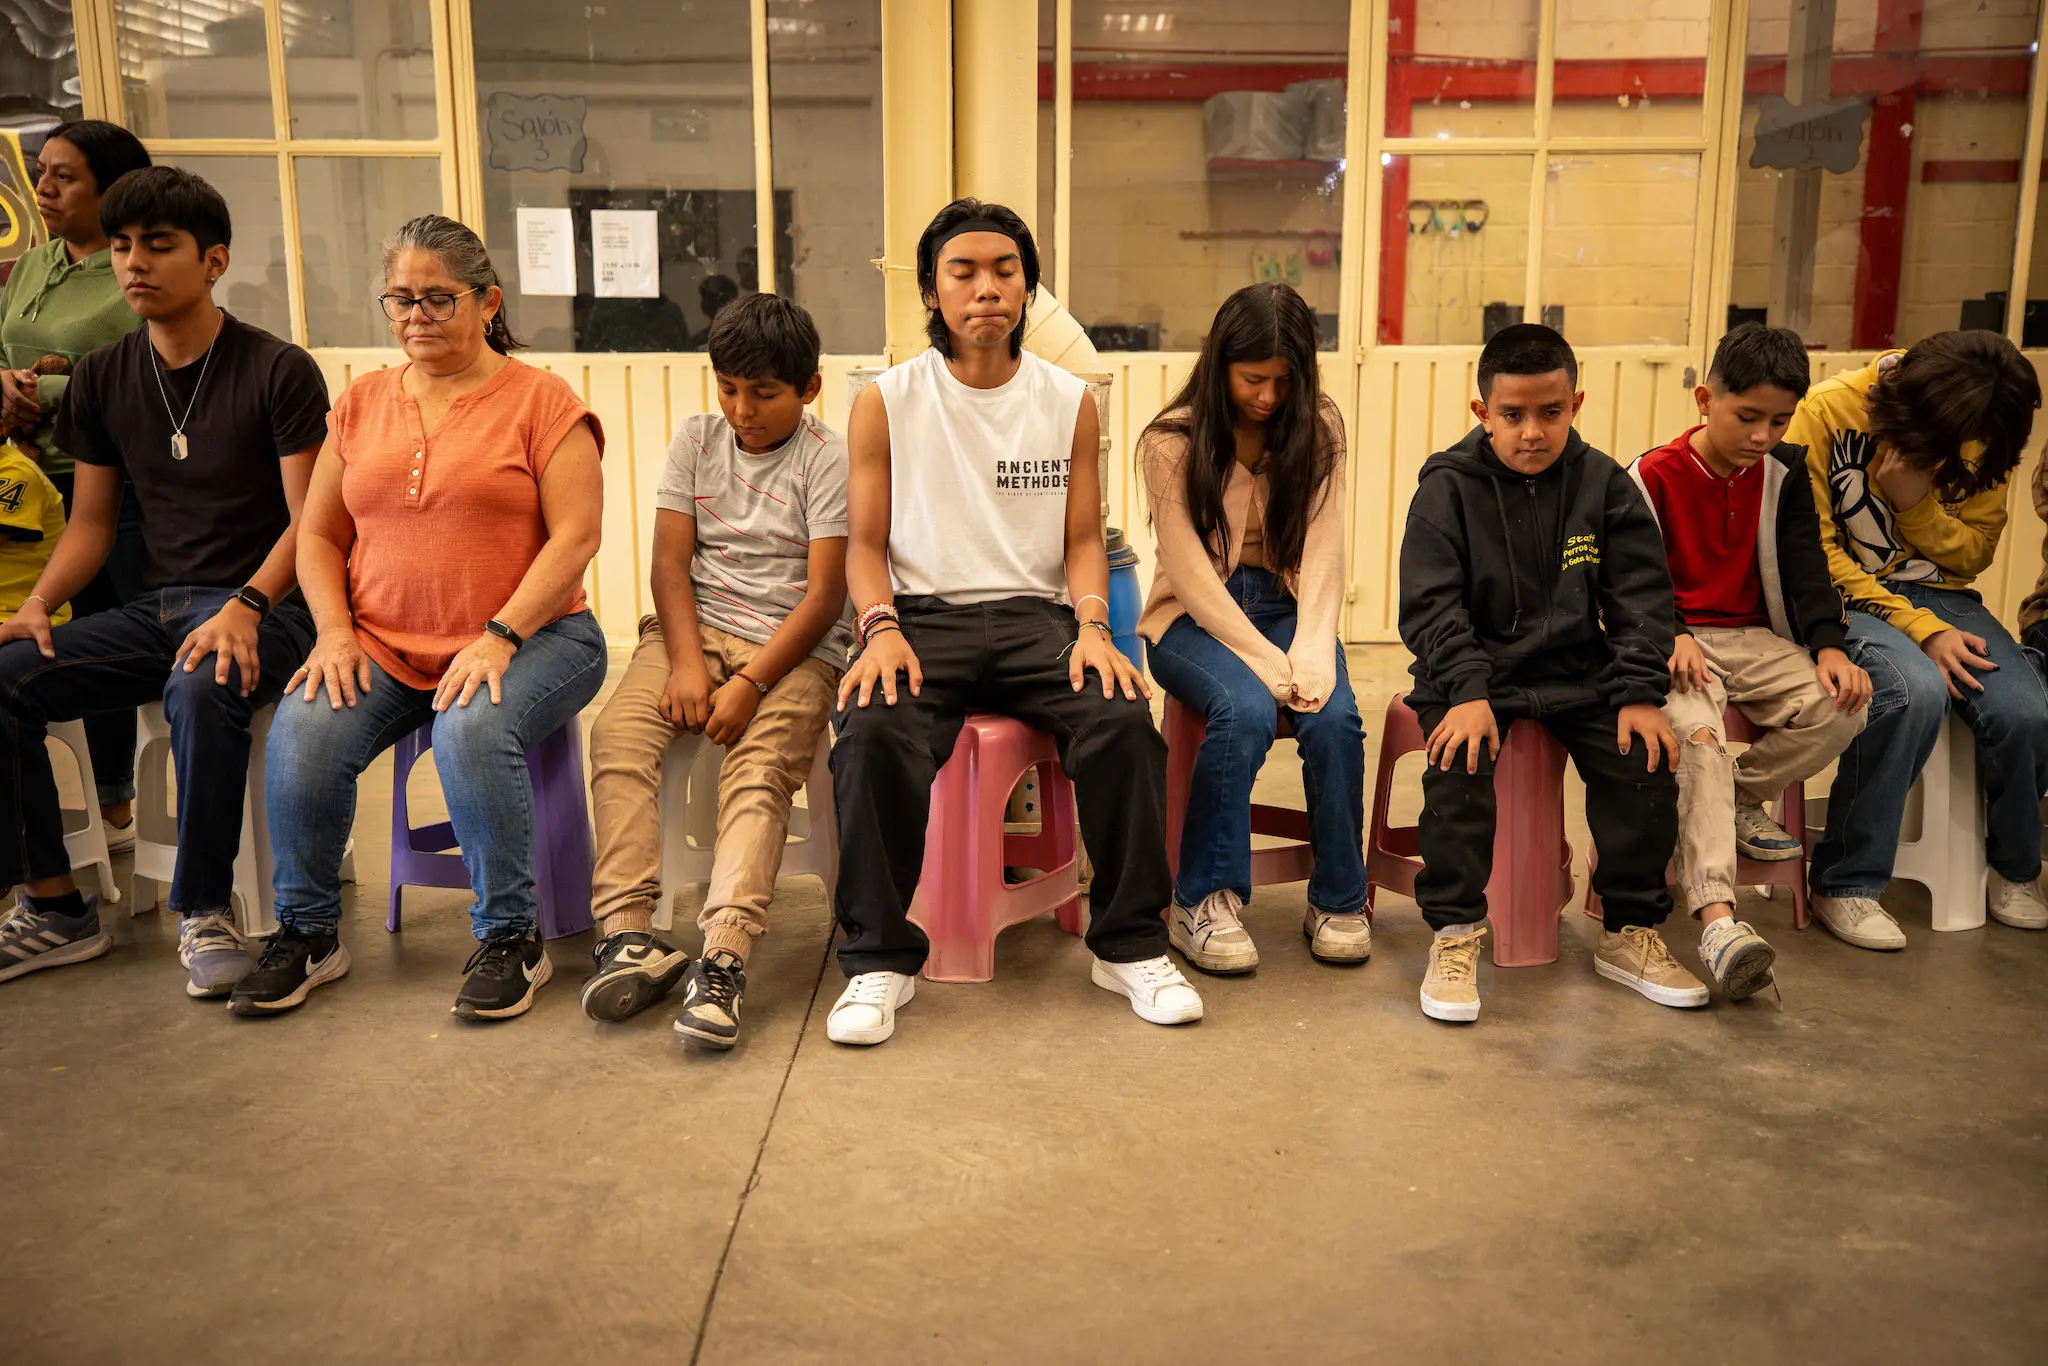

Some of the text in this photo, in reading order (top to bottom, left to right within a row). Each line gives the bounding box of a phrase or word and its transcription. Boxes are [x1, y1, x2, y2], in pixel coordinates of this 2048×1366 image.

[500, 111, 573, 142] Salón
[535, 139, 550, 162] 3
[996, 459, 1071, 474] ANCIENT
[996, 474, 1069, 489] METHODS
[1567, 534, 1595, 546] Staff
[1563, 544, 1588, 558] Perros
